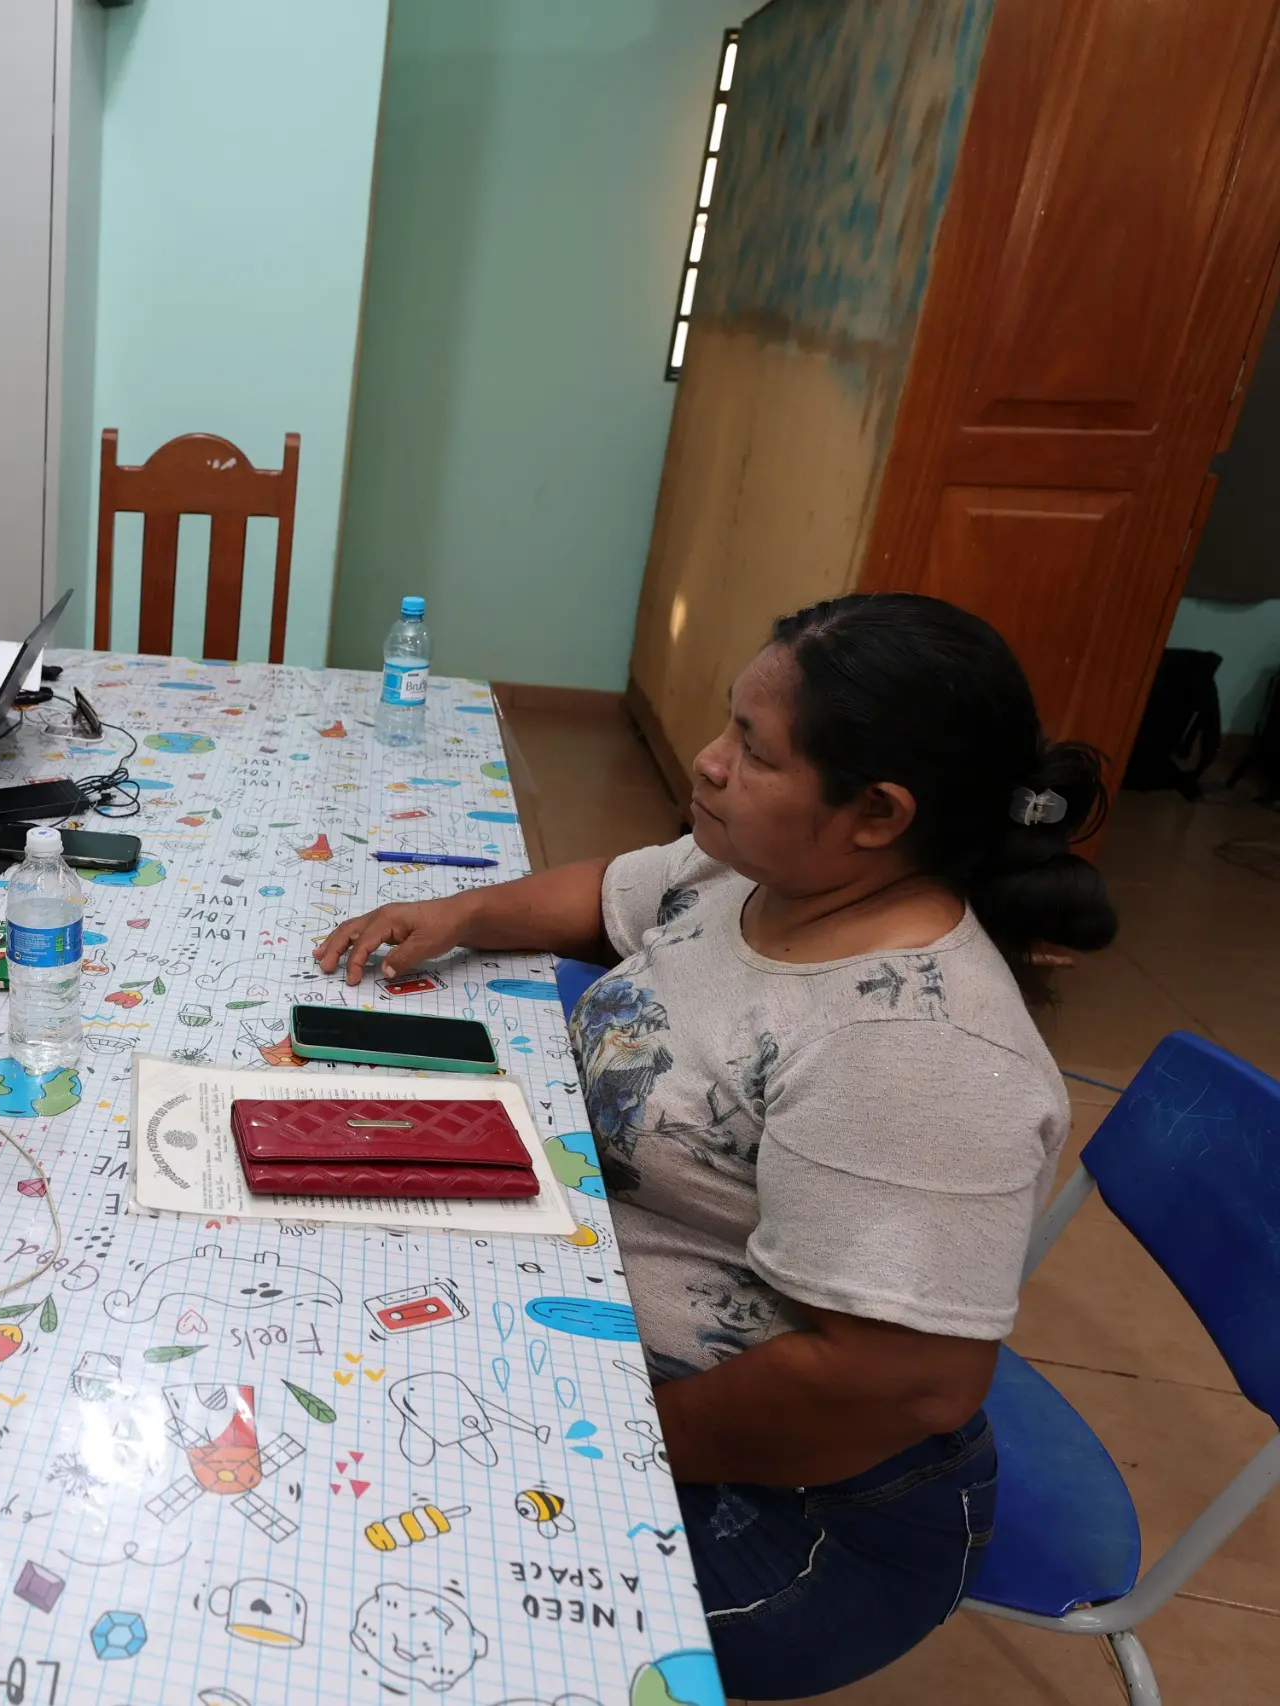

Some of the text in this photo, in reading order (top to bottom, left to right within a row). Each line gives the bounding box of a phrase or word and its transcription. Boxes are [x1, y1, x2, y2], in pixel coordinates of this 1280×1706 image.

[193, 893, 247, 906] LOVE
[178, 906, 235, 924] LOVE
[189, 926, 246, 941] LOVE
[124, 949, 192, 976] Good
[283, 990, 348, 1007] Feels
[3, 1238, 100, 1292] Good
[230, 1323, 323, 1360] Feels
[509, 1561, 639, 1592] A SPACE
[522, 1594, 644, 1634] I NEED
